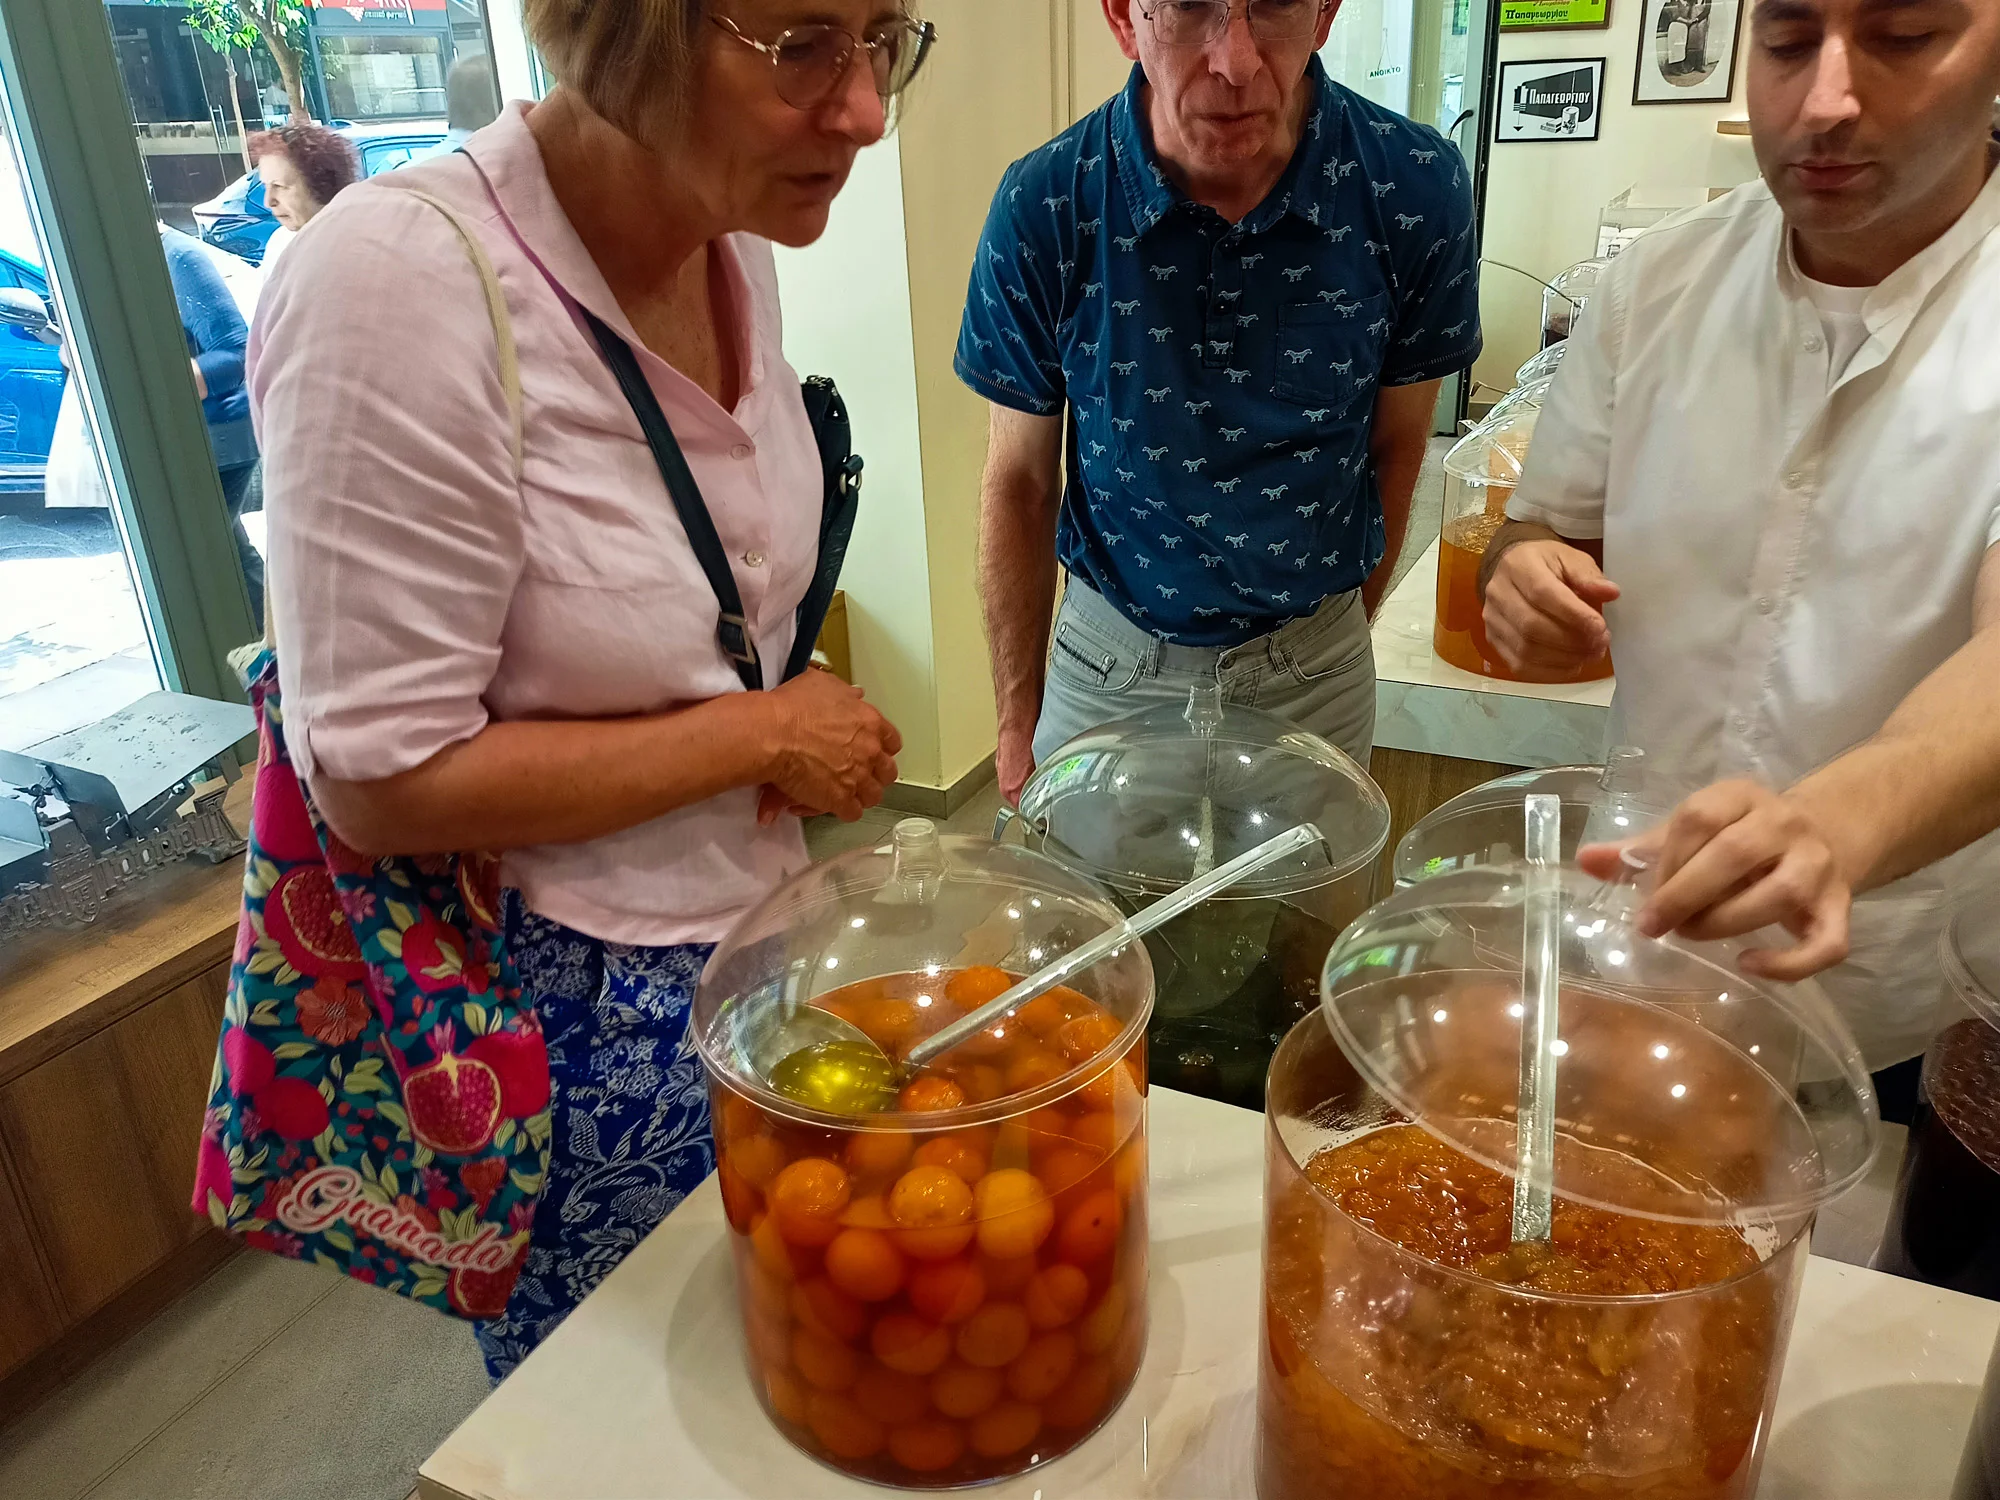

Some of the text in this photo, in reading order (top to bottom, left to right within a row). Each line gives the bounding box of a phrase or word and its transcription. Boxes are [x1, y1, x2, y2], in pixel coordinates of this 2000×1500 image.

[1369, 66, 1401, 78] ΑΝΟΙΚΤΟ
[1529, 88, 1591, 105] ΠΑΠΑΓΕΩΡΓΙΟΥ
[277, 1166, 513, 1272] Granada
